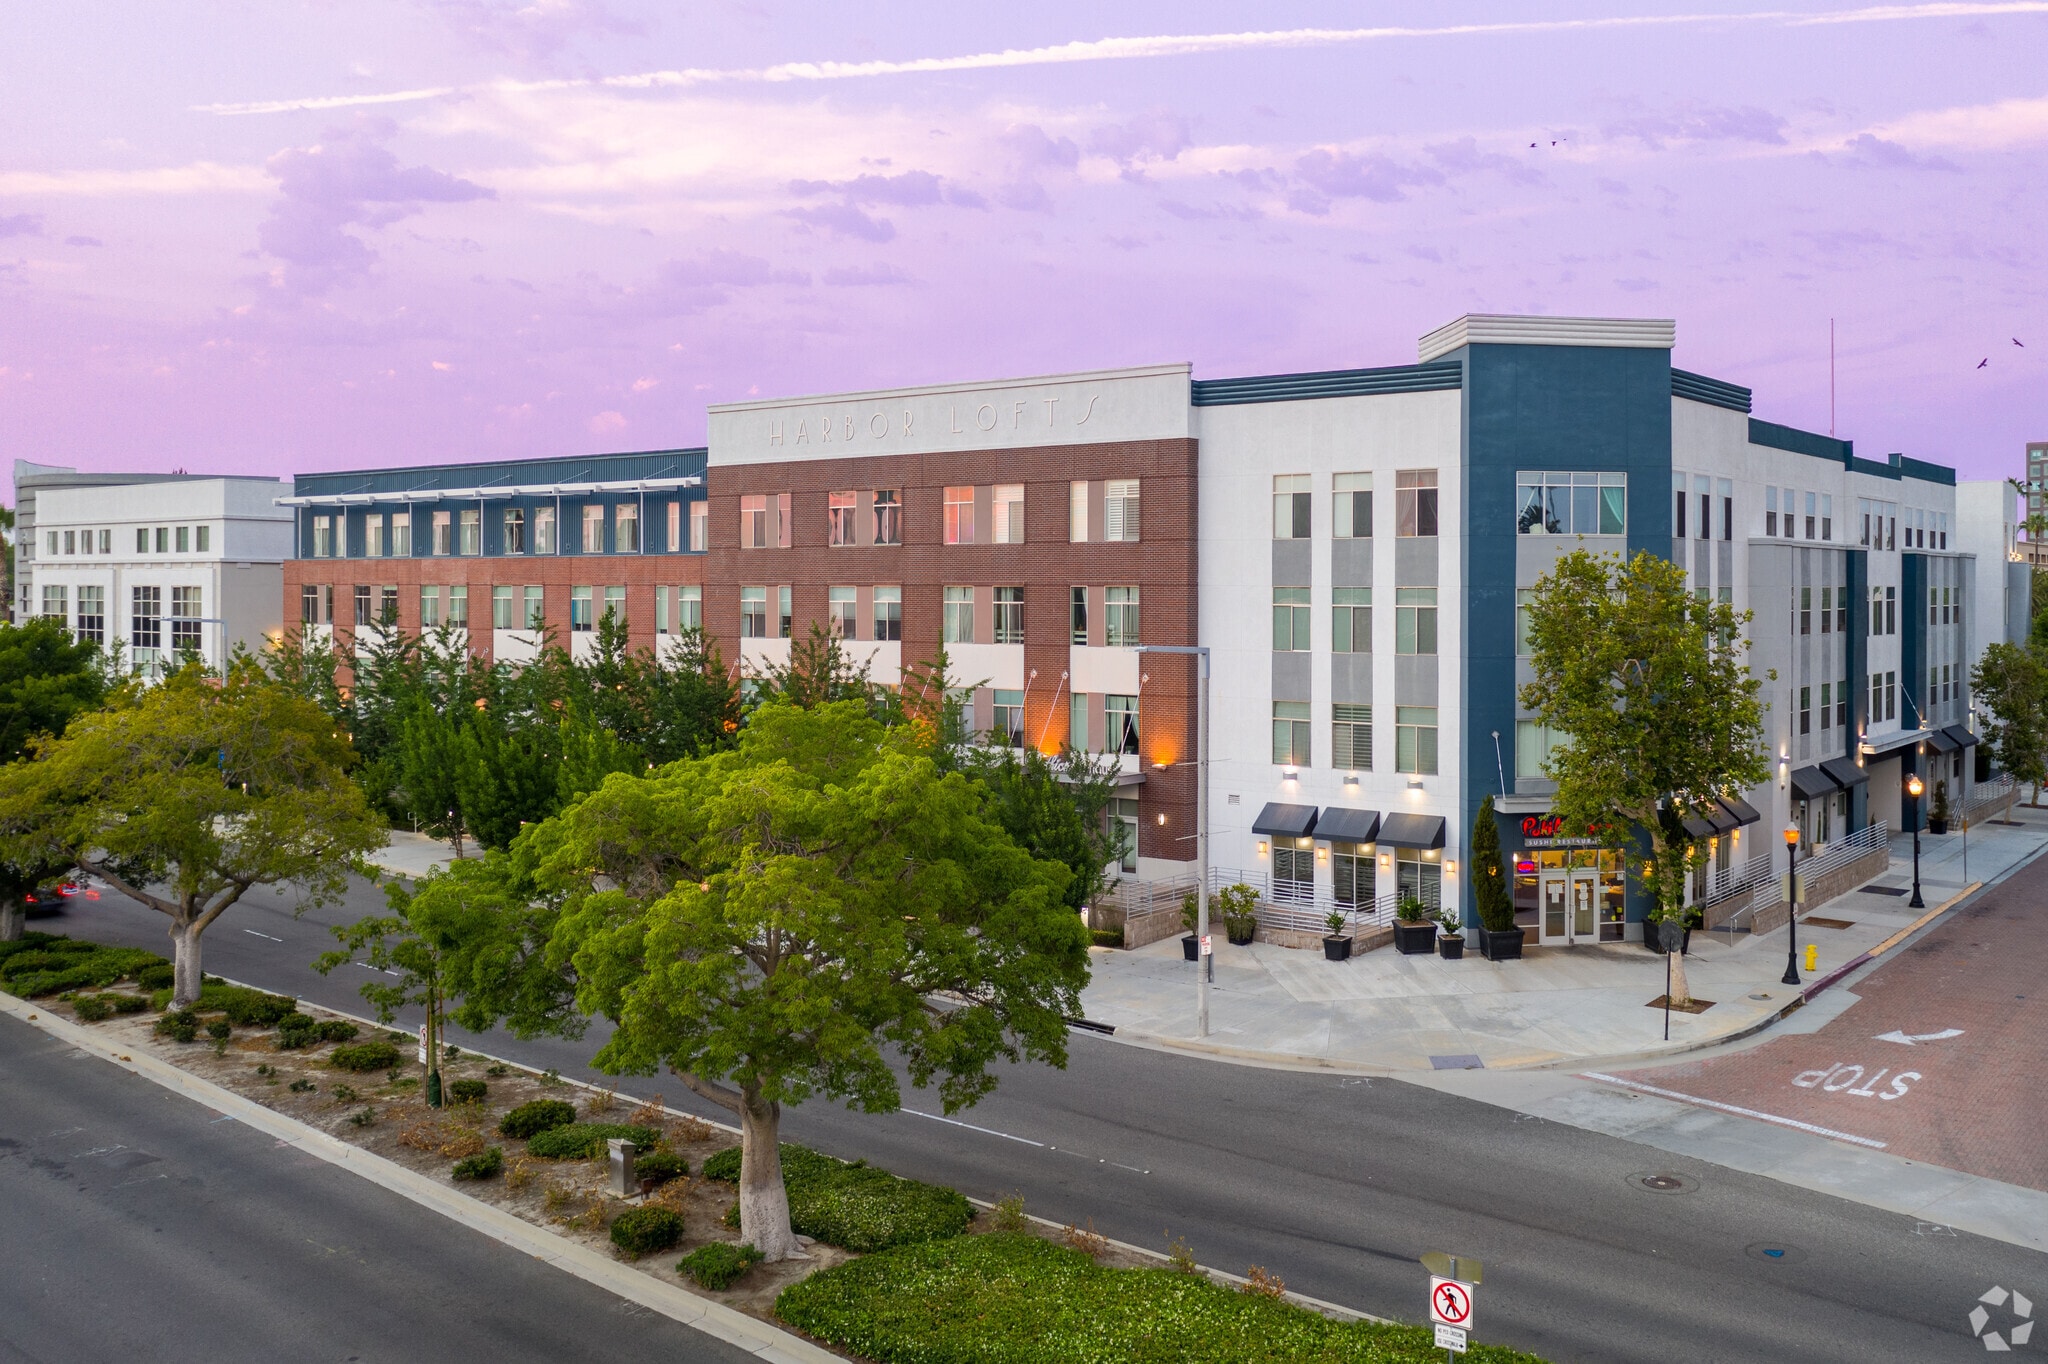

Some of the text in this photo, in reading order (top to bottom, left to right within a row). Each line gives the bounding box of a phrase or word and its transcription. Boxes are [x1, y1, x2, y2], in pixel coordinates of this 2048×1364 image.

[769, 395, 1099, 447] HARBOR LOFTS
[1791, 1062, 1922, 1100] STOP
